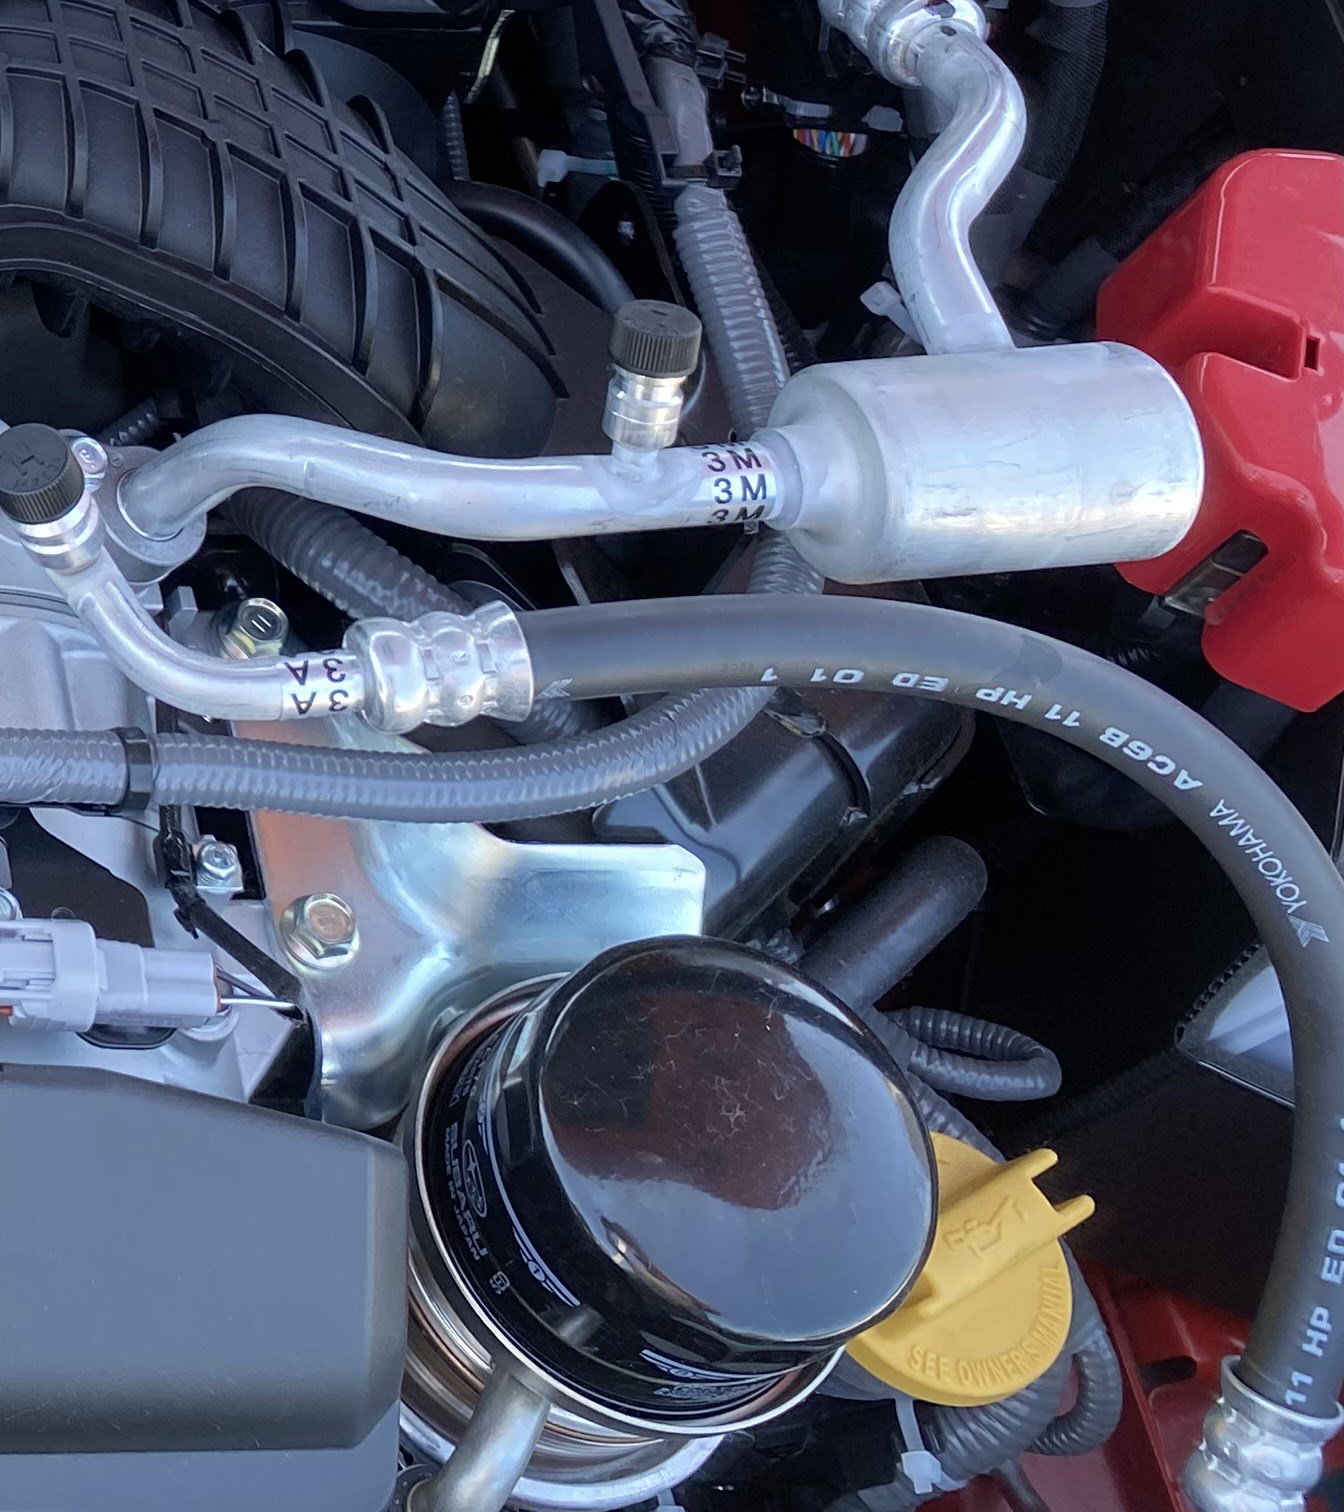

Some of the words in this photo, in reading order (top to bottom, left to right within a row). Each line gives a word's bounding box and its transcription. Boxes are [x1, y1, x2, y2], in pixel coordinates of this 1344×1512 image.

[714, 473, 767, 504] 3M
[290, 689, 349, 715] 3A
[891, 672, 950, 692] ED
[976, 687, 1034, 710] HP
[1044, 703, 1081, 728] 11
[1209, 799, 1308, 914] YOKOHAMA
[450, 1122, 488, 1257] SUBARU
[453, 1204, 481, 1261] JAPAN
[909, 1344, 950, 1381] SEE
[957, 1339, 1041, 1387] OWNER'S
[1029, 1260, 1066, 1349] MANUAL
[1301, 1306, 1333, 1357] HP
